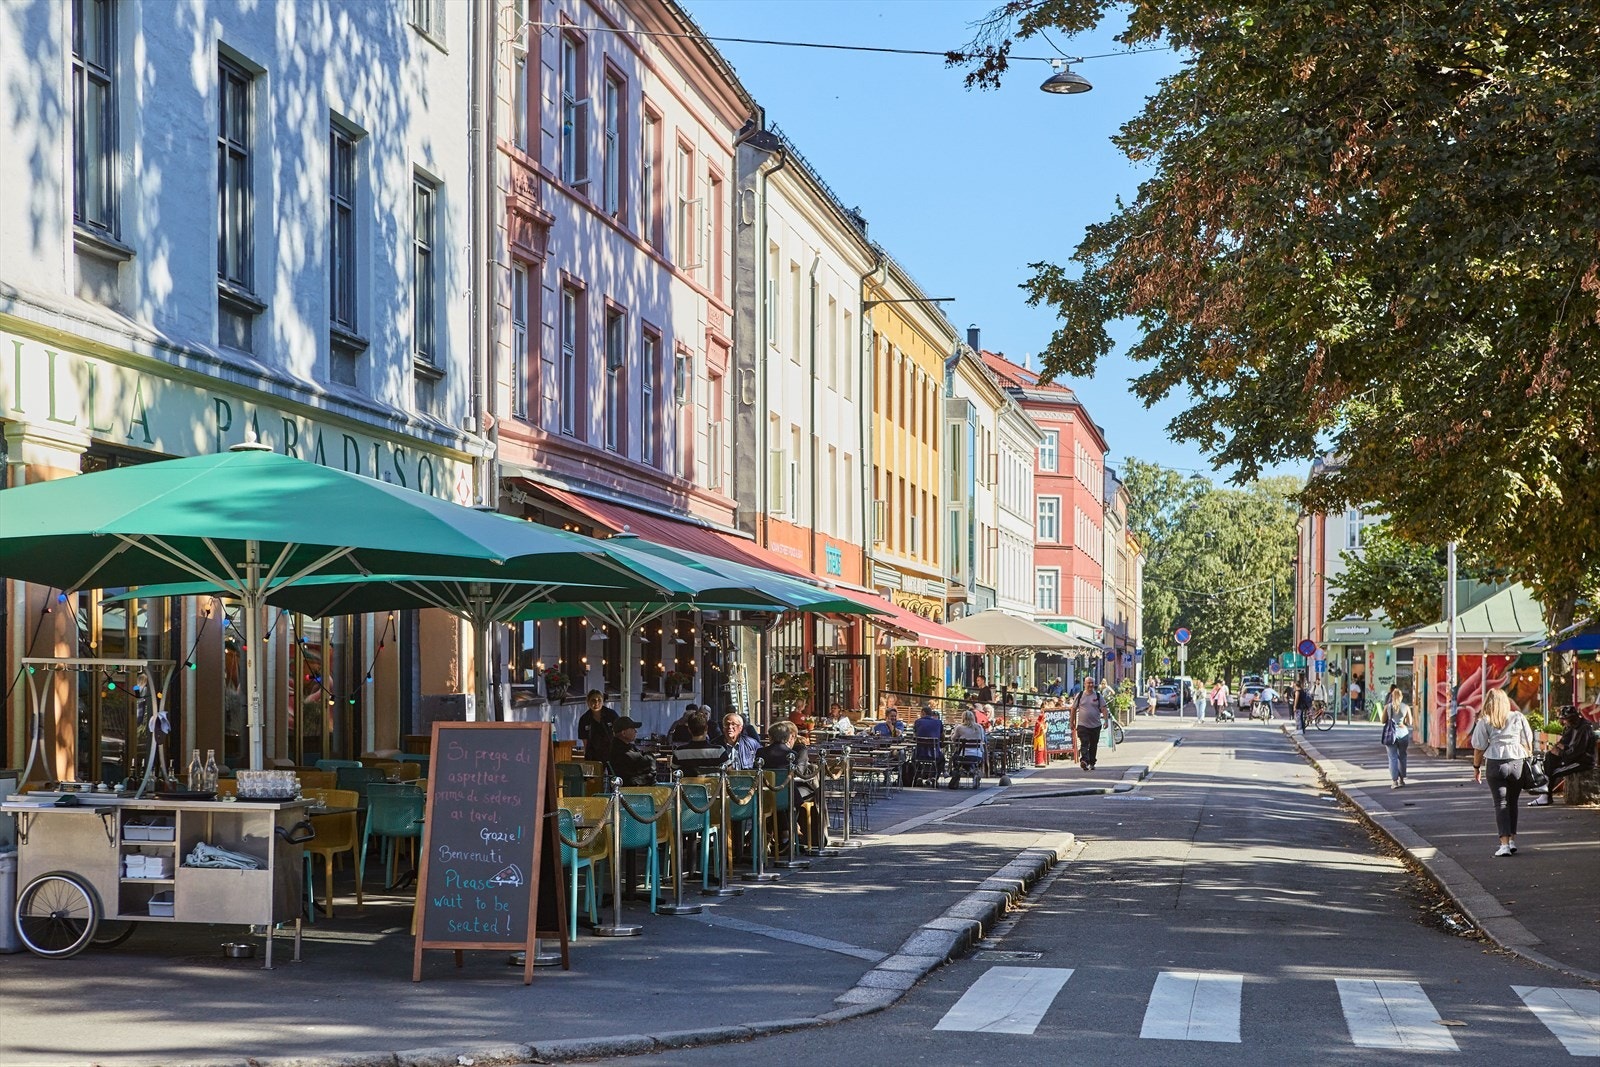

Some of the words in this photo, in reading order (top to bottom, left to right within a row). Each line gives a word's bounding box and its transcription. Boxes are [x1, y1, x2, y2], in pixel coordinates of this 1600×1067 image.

[213, 397, 434, 496] PARADISO
[1045, 711, 1070, 720] DAGENS
[447, 741, 468, 761] Si
[475, 750, 509, 771] prega
[516, 747, 530, 763] di
[448, 771, 508, 787] aspettare
[467, 789, 478, 802] di
[439, 845, 504, 863] Benvenuti
[445, 869, 495, 890] Please
[433, 894, 463, 909] wait
[476, 897, 487, 910] to
[494, 895, 509, 911] be
